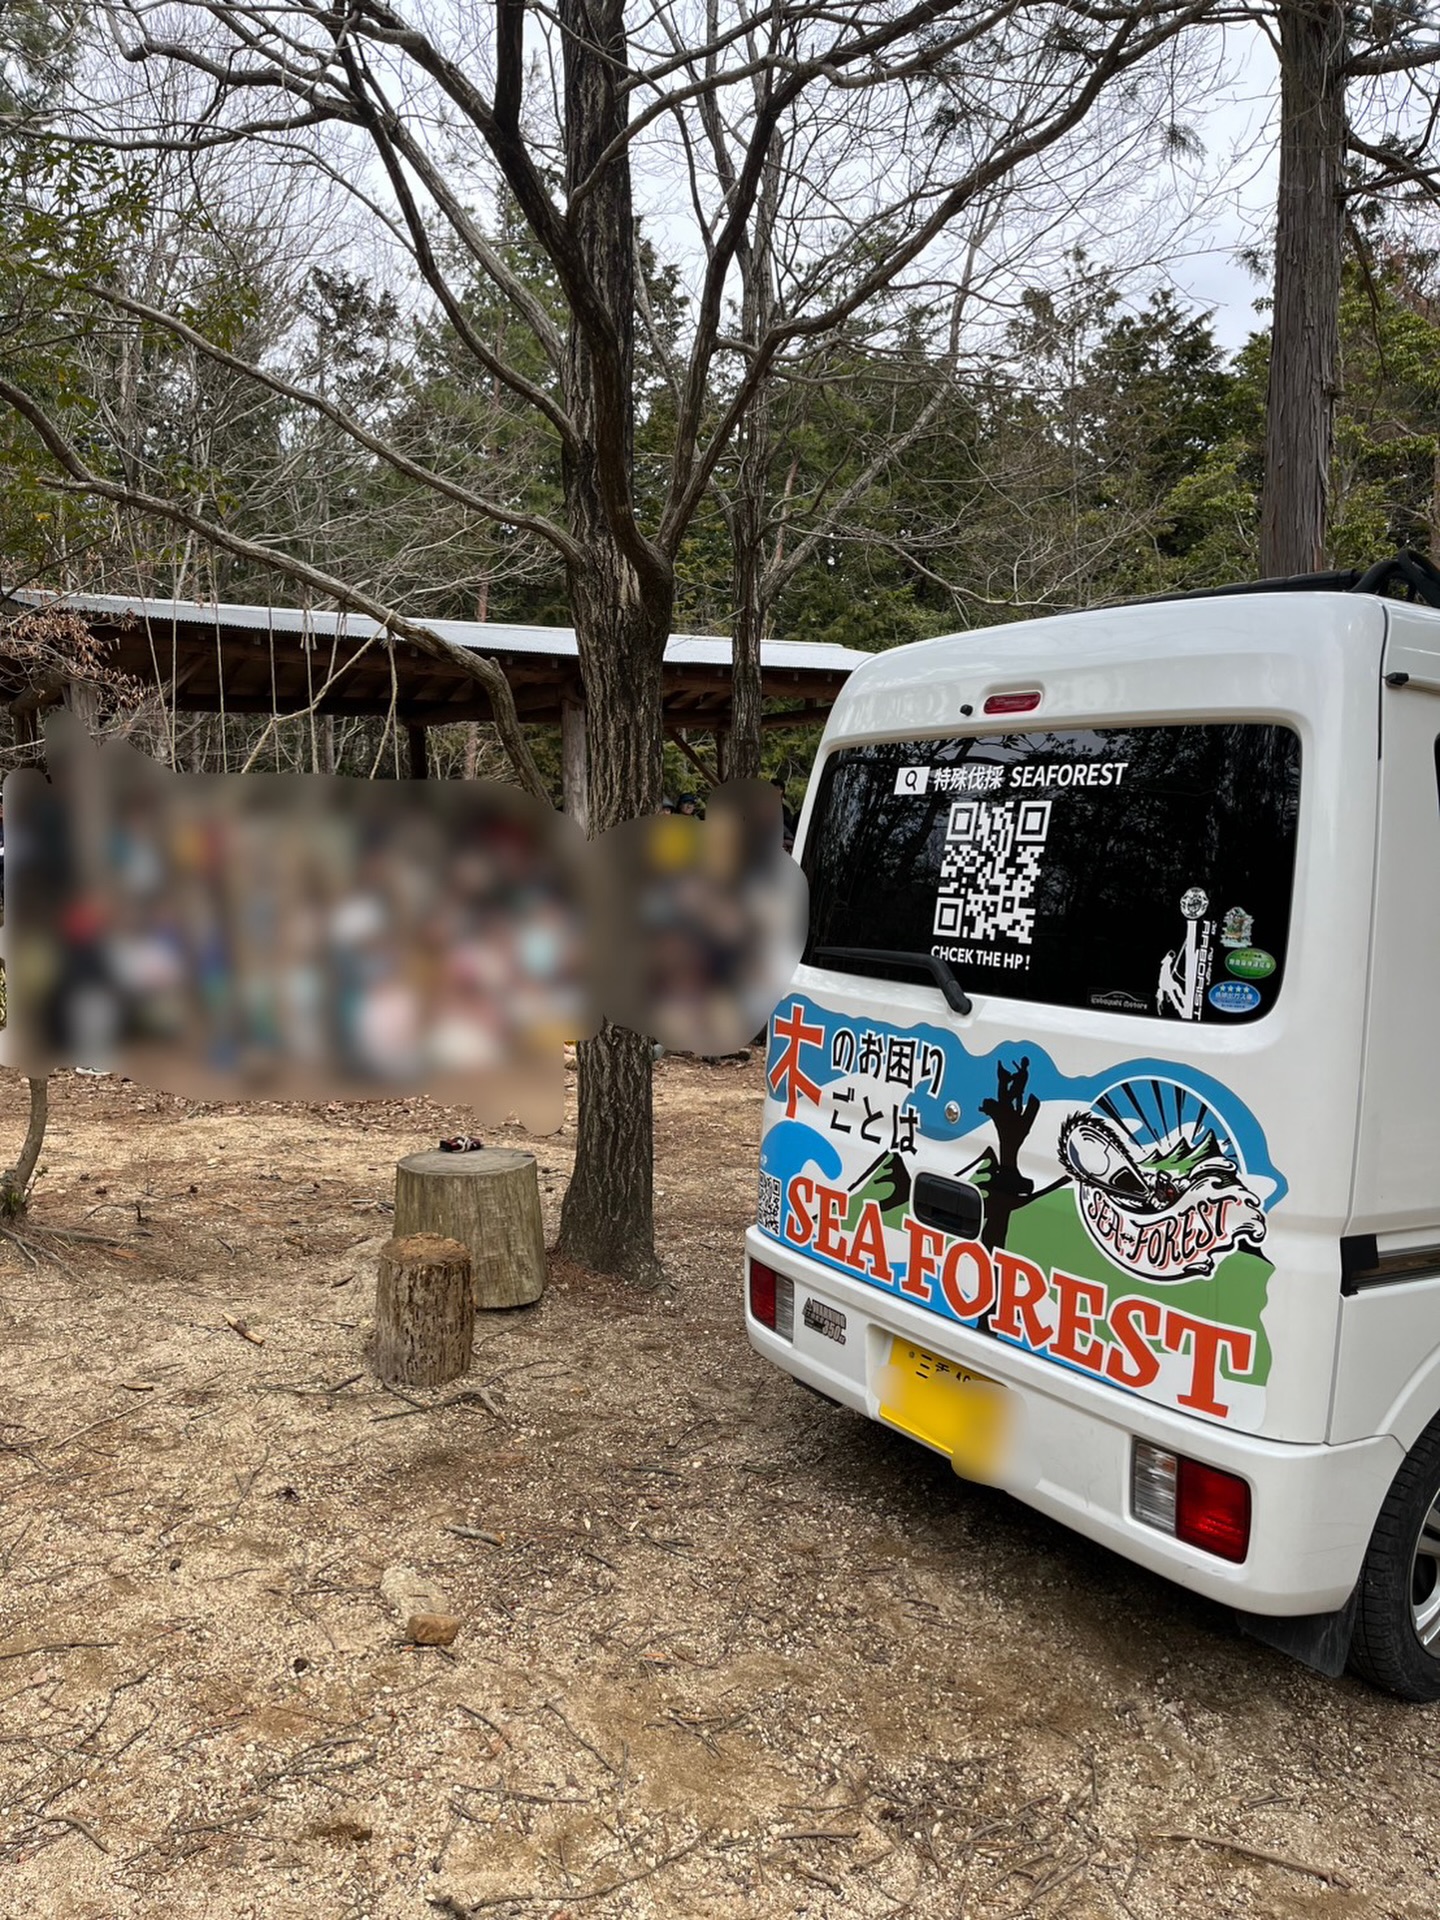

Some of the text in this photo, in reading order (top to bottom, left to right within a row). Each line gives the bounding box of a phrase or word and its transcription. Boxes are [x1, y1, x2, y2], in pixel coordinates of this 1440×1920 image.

[932, 763, 1128, 792] 特殊伐採 SEAFOREST
[931, 945, 974, 965] CHCEK
[976, 949, 1002, 968] THE
[830, 1087, 920, 1156] ごとは
[1088, 1191, 1239, 1269] SEA FOREST
